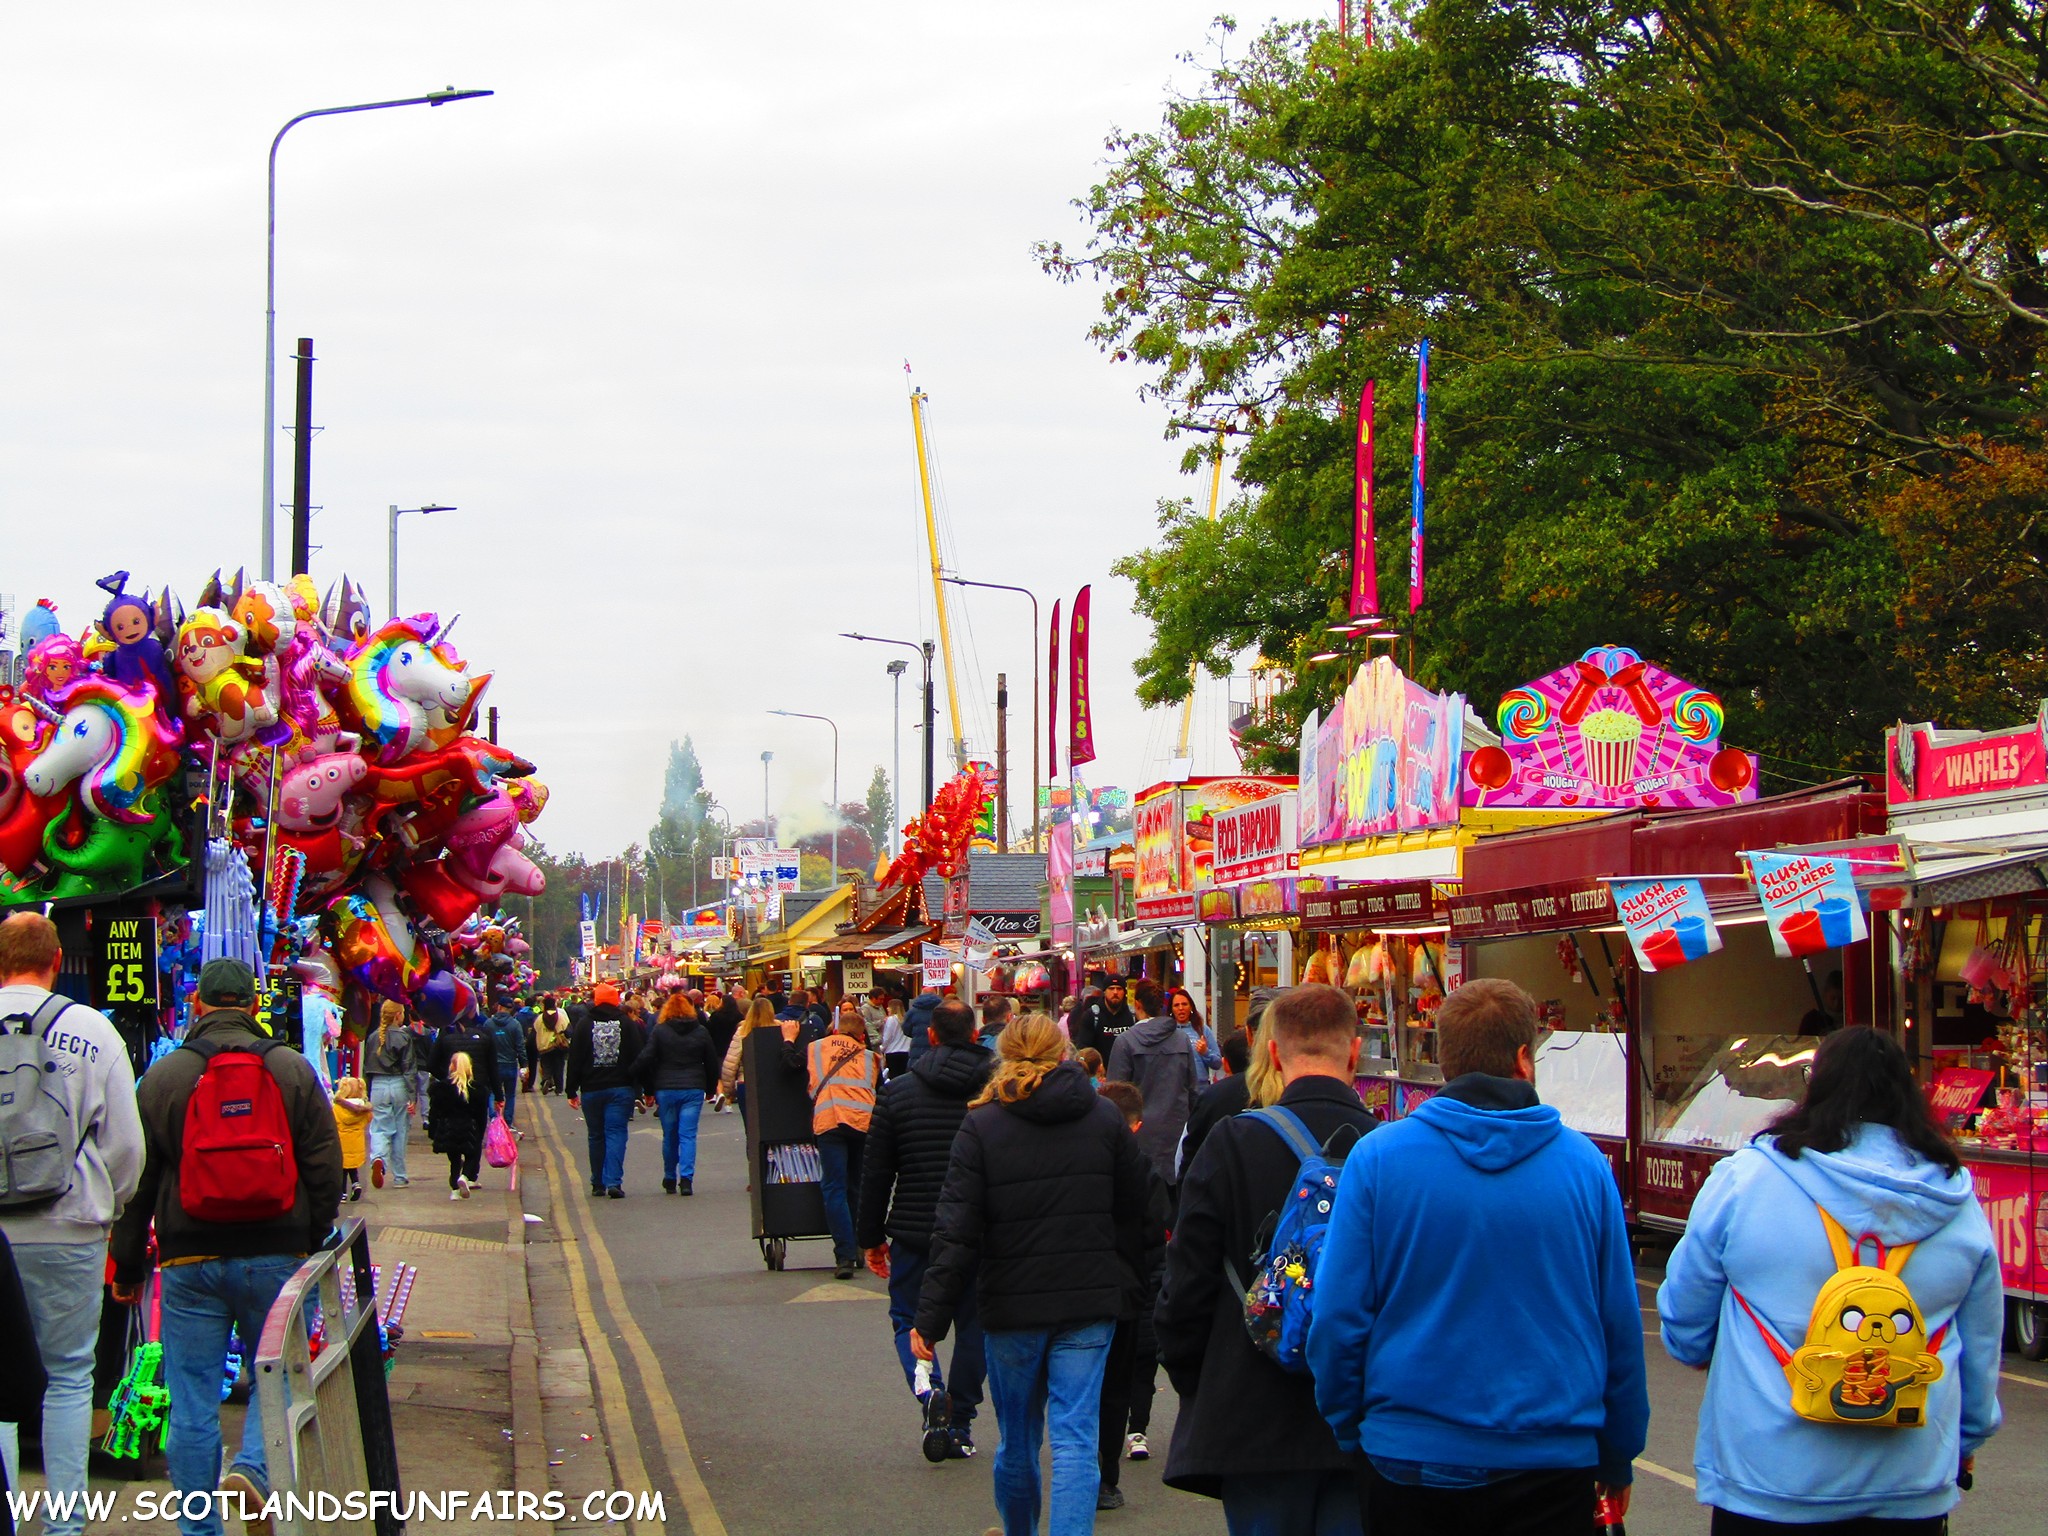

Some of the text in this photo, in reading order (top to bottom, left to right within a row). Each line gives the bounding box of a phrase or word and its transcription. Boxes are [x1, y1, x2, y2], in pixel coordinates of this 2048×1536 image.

[1945, 744, 2020, 788] WAFFLES
[1542, 774, 1580, 789] NOUGAT
[1633, 774, 1669, 795] NOUGAT
[1217, 816, 1238, 862] FOOD
[1240, 804, 1281, 858] EMPORIUM
[1760, 857, 1811, 890] SLUSH
[1764, 861, 1836, 903] SOLD HERE
[1306, 893, 1422, 918] HANDMADE TOFFEE FUDGE TRUFFLES
[1452, 888, 1607, 926] HANDMADE TOFFEE FUDGE TRUFFLES
[1620, 881, 1666, 914] SLUSH
[1625, 884, 1689, 926] SOLD HERE
[109, 920, 139, 938] ANY
[978, 914, 1041, 932] Nice &
[107, 942, 142, 960] ITEM
[850, 971, 865, 979] HOT
[924, 958, 950, 969] BRANDY
[928, 969, 946, 980] SNAP
[107, 963, 145, 1002] £5
[848, 981, 868, 989] DOGS
[831, 1039, 851, 1048] HULL
[1646, 1156, 1684, 1190] TOFFEE
